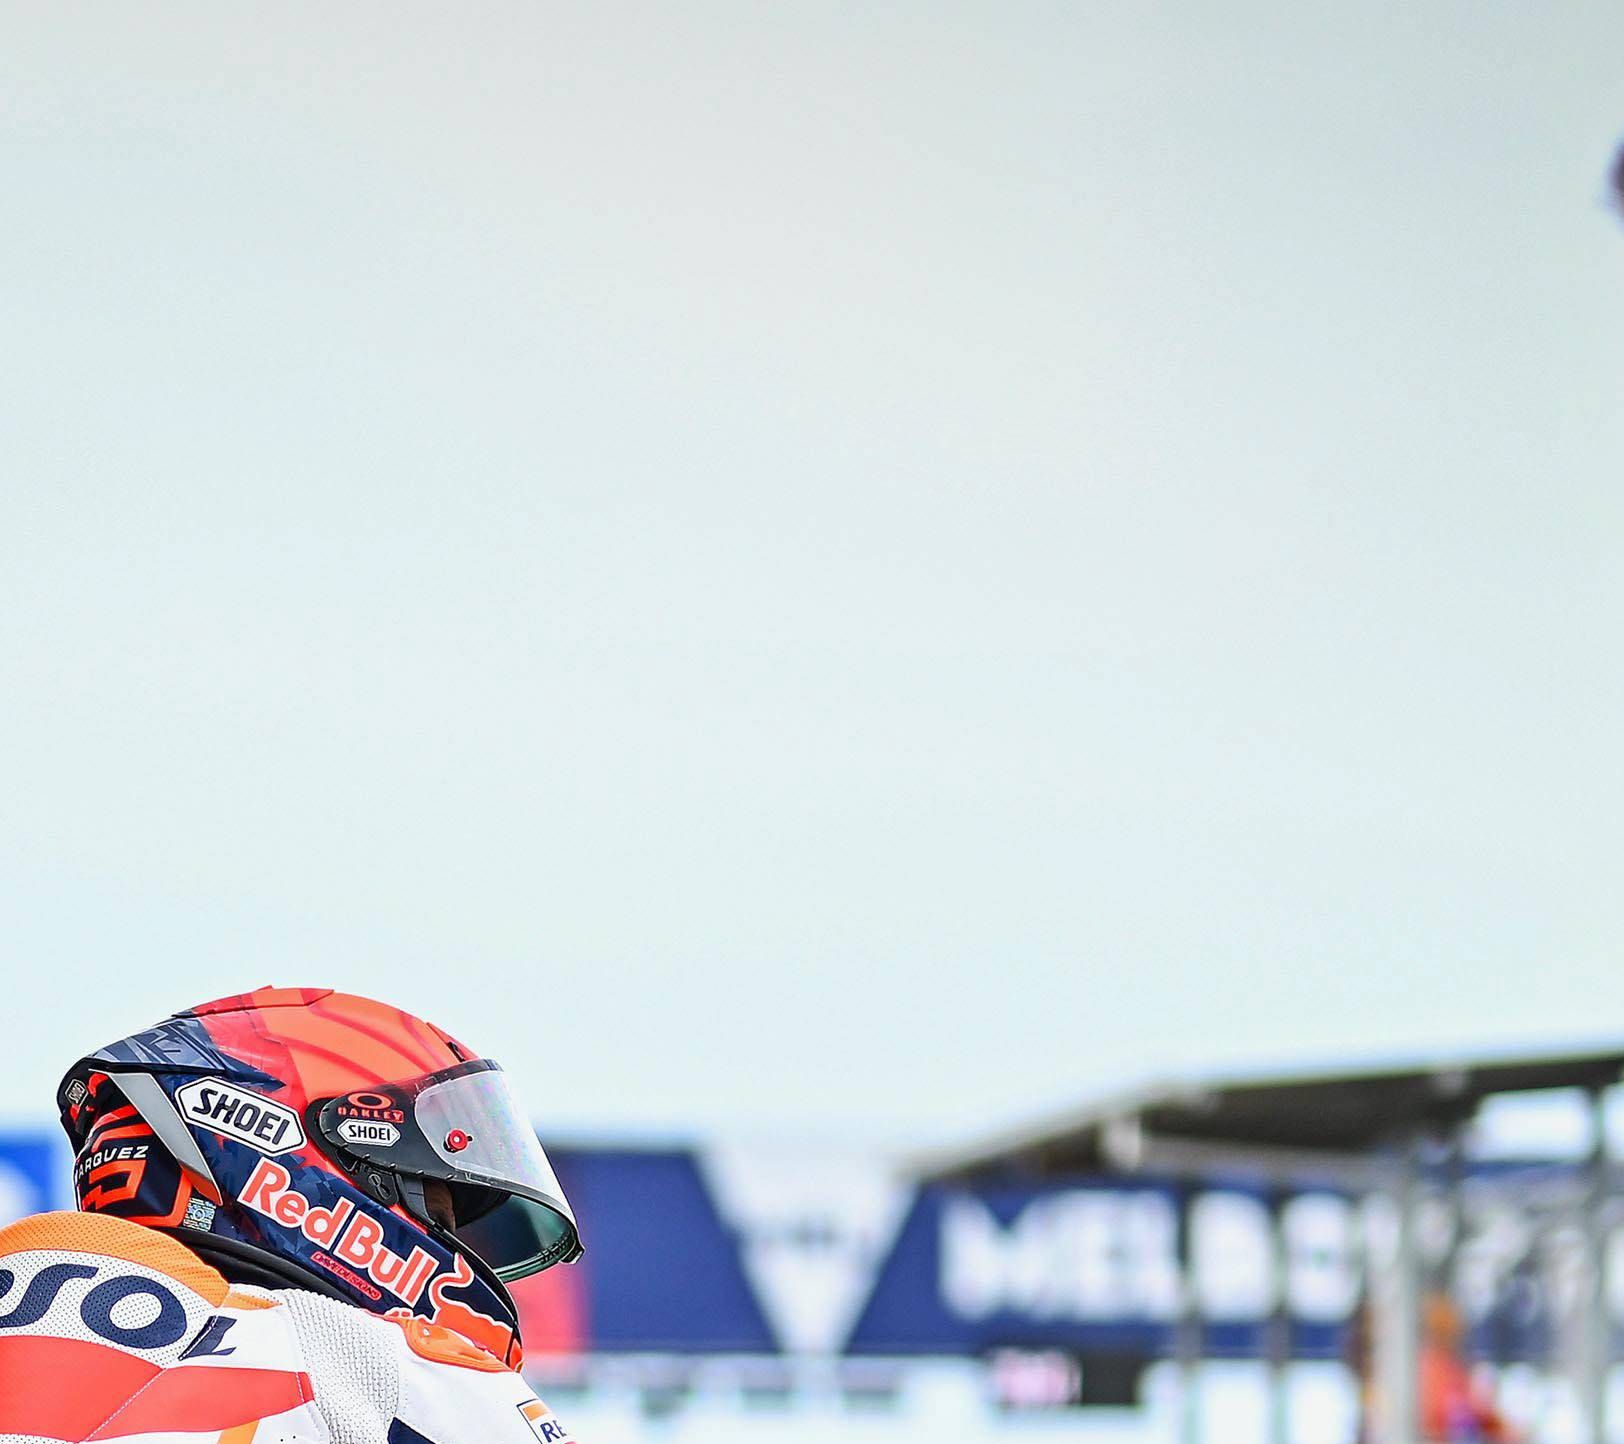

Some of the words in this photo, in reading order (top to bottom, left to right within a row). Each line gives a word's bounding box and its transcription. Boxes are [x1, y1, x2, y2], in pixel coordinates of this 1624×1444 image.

[192, 1087, 289, 1146] SHOEI
[337, 1106, 404, 1123] OAKLEY
[348, 1124, 392, 1142] SHOEI
[75, 1145, 149, 1181] ARQUEZ
